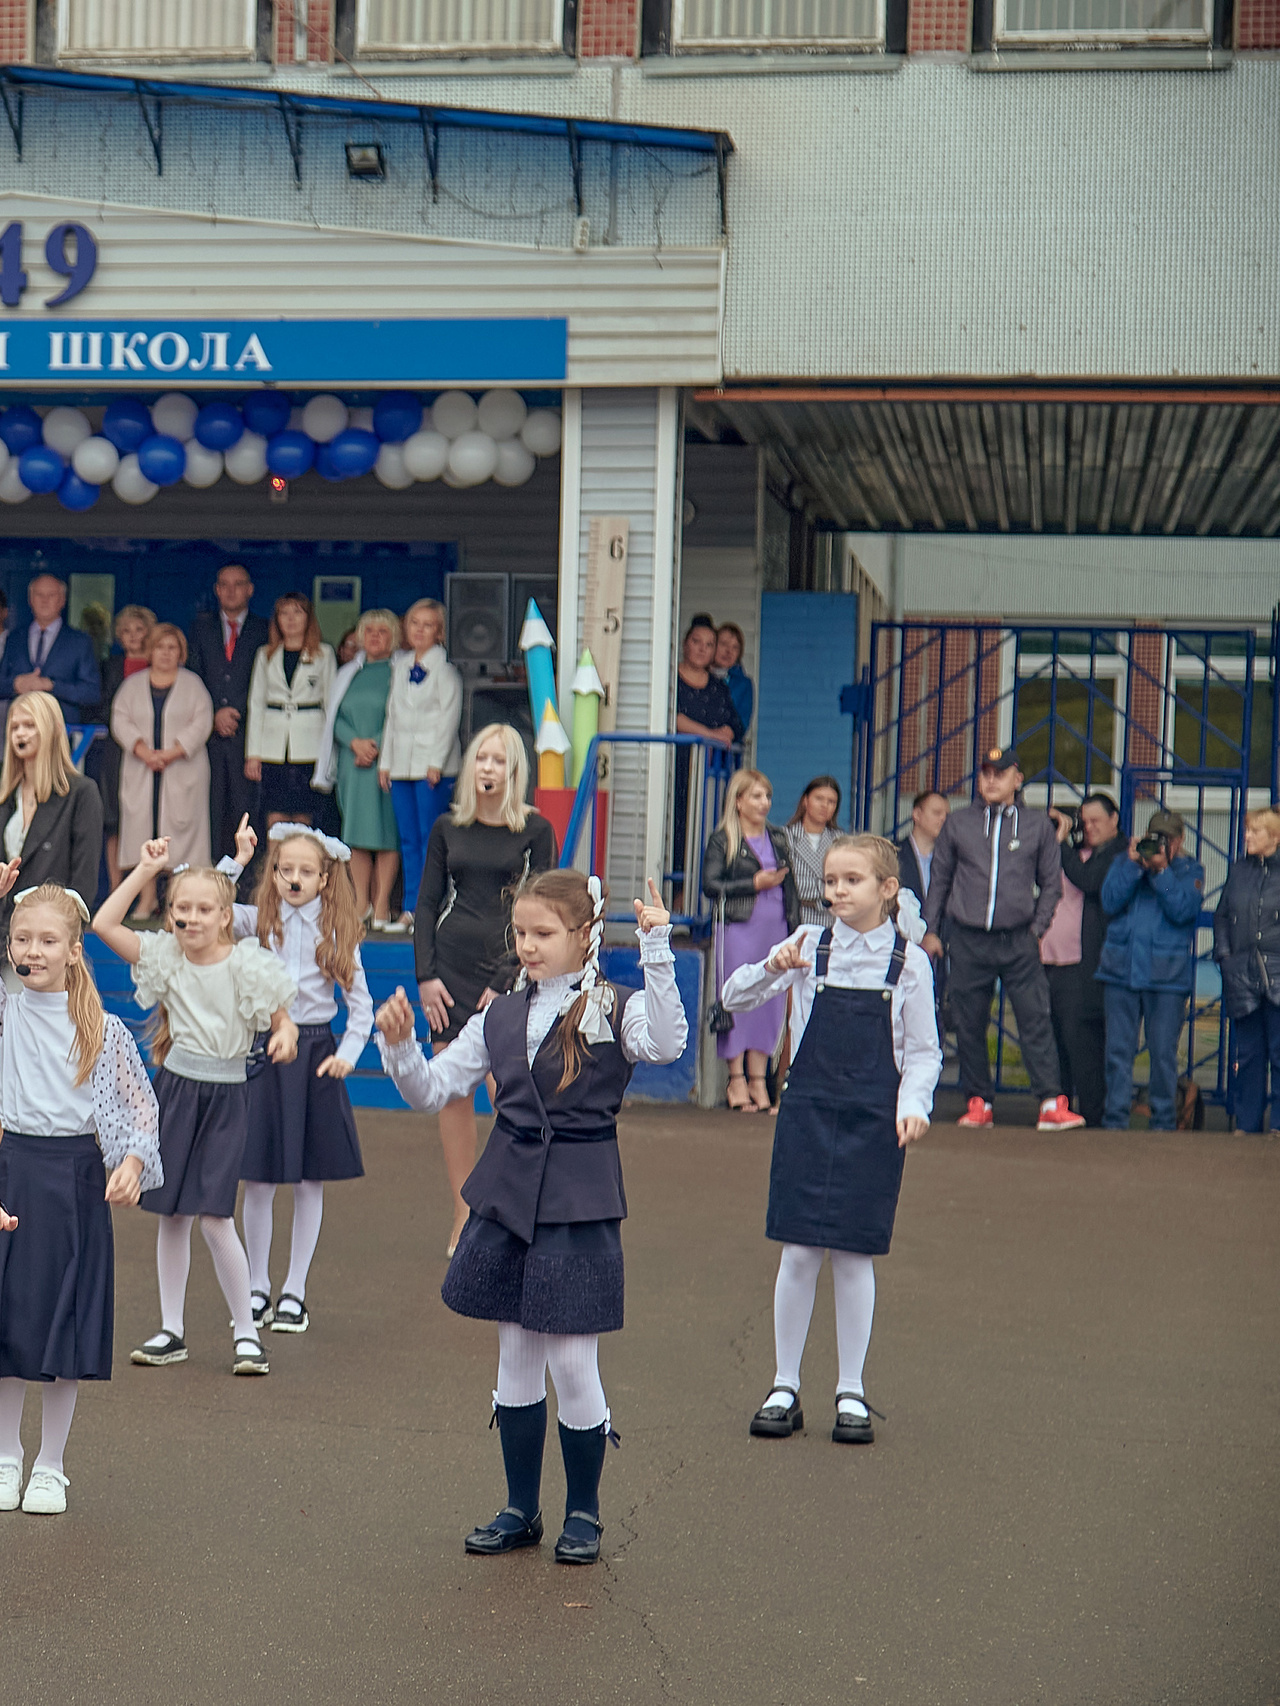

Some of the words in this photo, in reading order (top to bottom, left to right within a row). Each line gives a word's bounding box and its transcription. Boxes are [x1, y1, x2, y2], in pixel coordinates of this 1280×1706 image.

[48, 332, 273, 372] ШКОЛА
[610, 535, 624, 561] 6
[604, 607, 620, 634] 5
